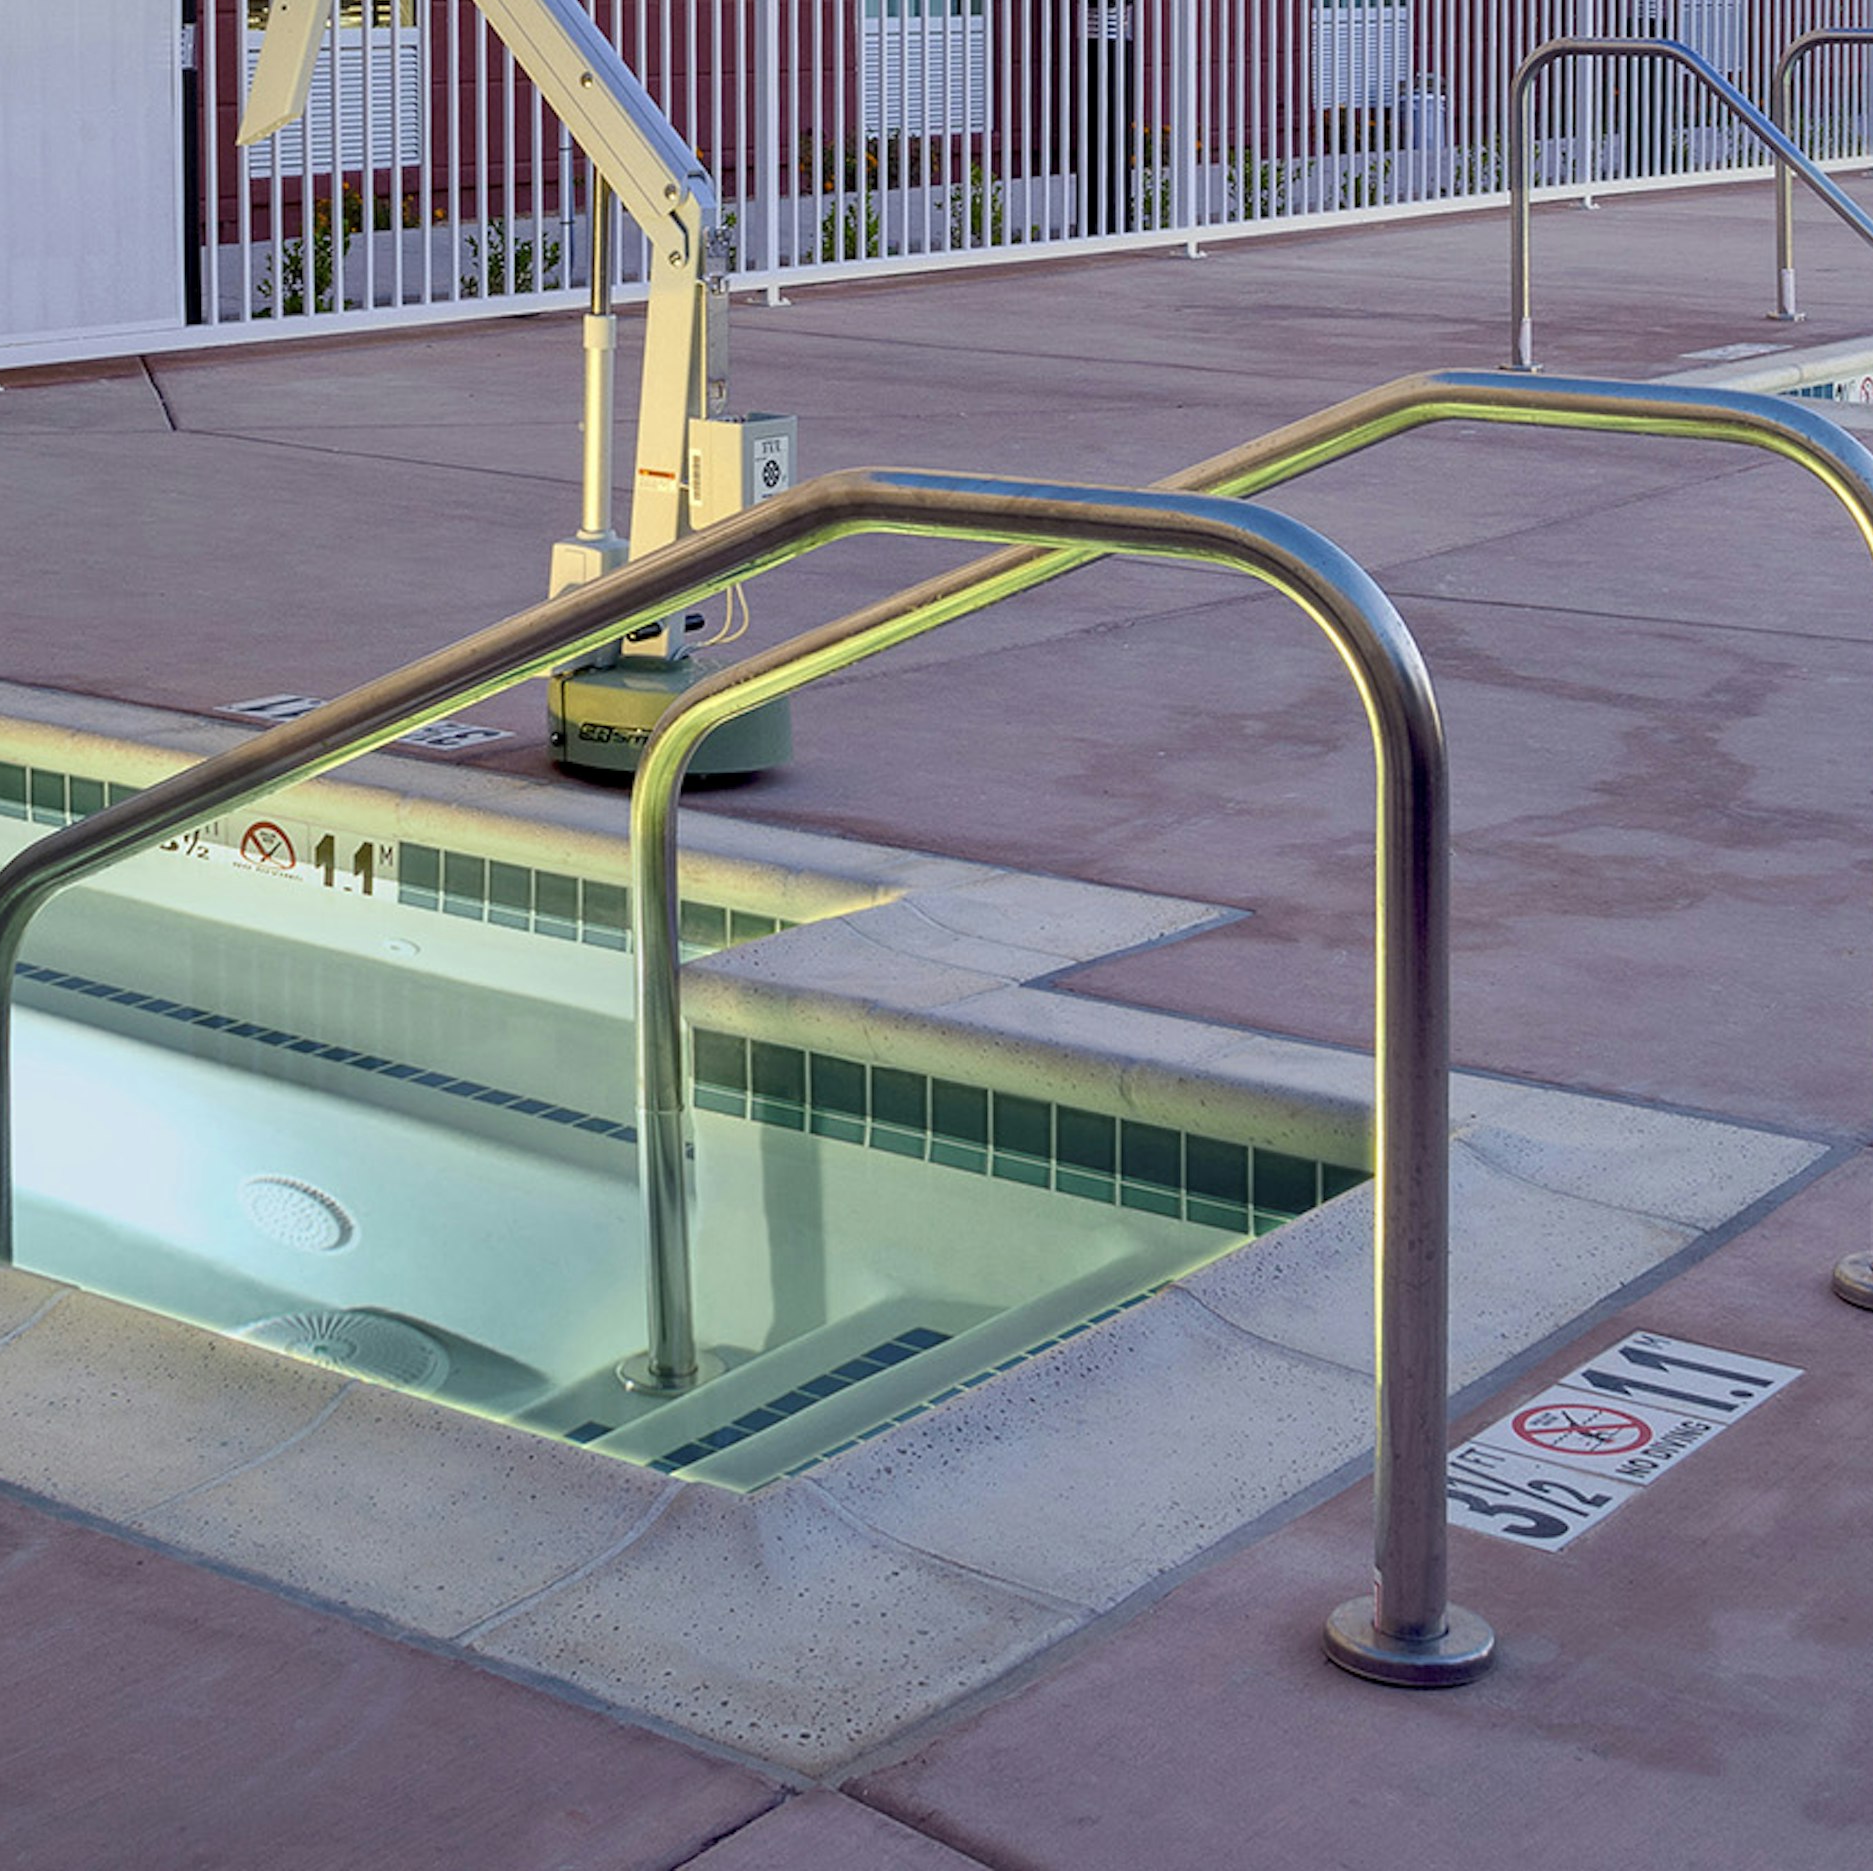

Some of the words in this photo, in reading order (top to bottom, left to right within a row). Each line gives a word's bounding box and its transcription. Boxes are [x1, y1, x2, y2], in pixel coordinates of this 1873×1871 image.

[379, 844, 393, 867] M
[1632, 1334, 1672, 1350] M
[1456, 1447, 1506, 1469] FT
[1615, 1457, 1652, 1479] NO
[1653, 1420, 1713, 1461] DIVING
